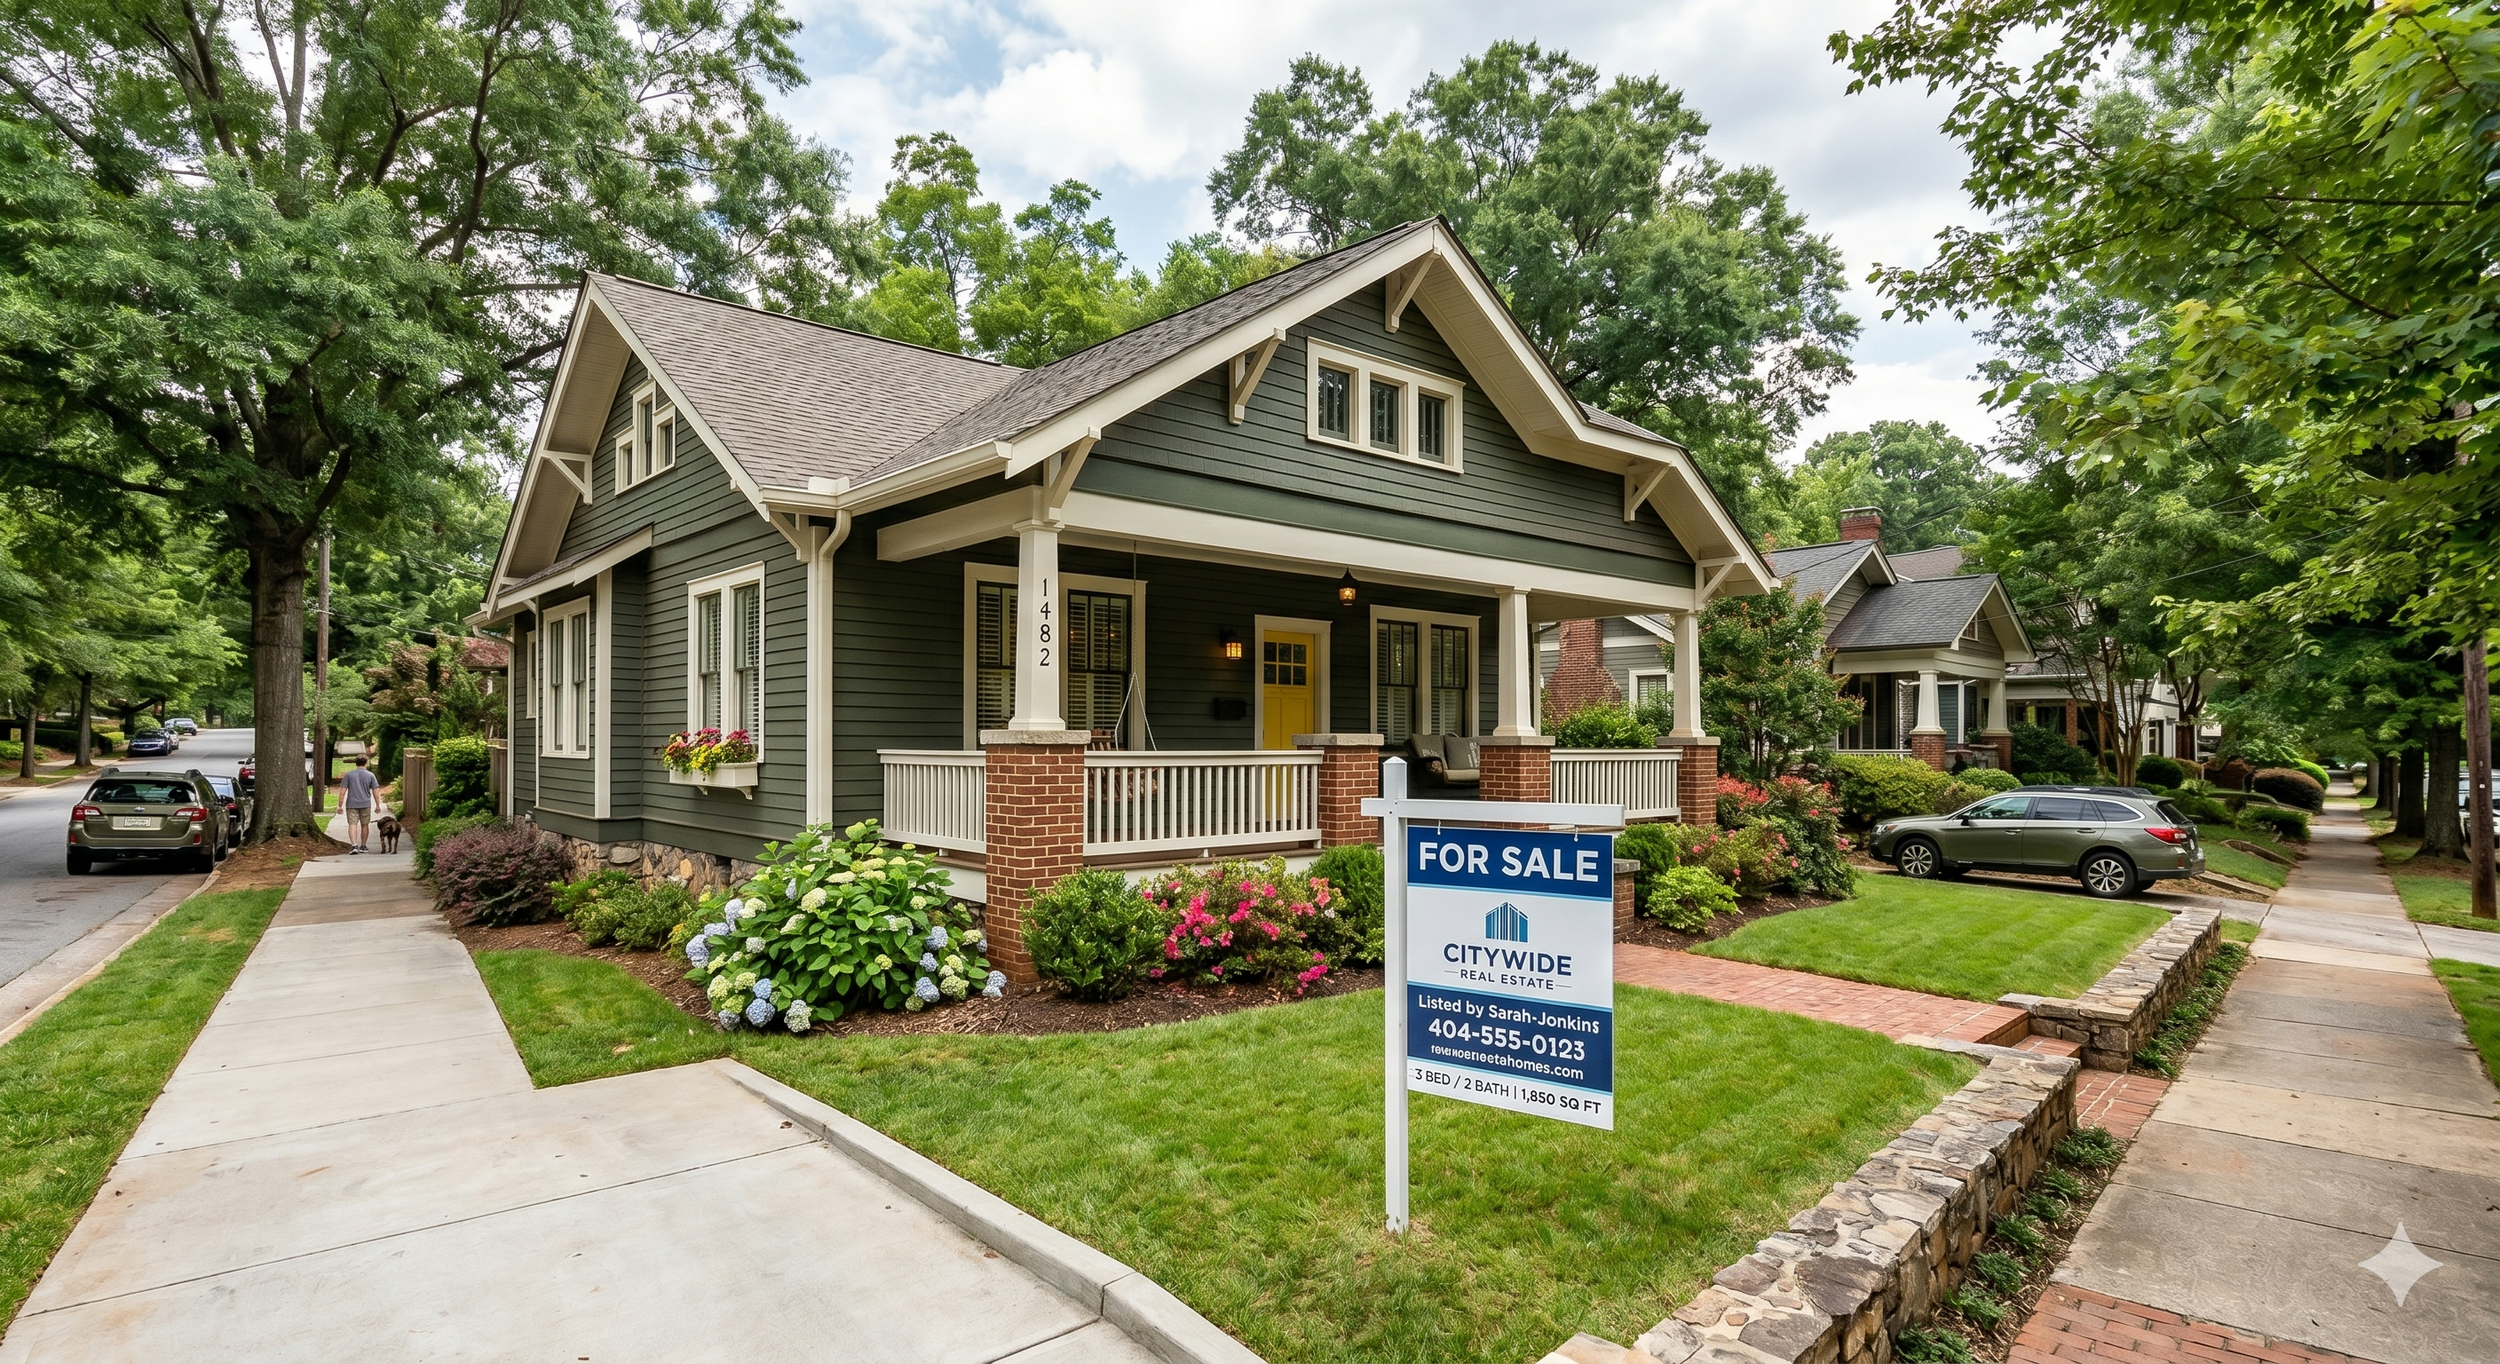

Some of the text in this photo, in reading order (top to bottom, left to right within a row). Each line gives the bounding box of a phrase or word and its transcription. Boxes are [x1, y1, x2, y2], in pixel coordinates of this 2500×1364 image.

[1039, 577, 1052, 667] 1482
[1419, 841, 1599, 883] FOR SALE
[1443, 943, 1572, 976] CITYWIDE
[1460, 969, 1554, 990] REAL ESTATE
[1418, 994, 1600, 1034] Listed by Sarah-Jonkins
[1428, 1018, 1586, 1061] 404-555-0123
[1414, 1068, 1423, 1080] 3
[1425, 1070, 1451, 1085] BED
[1464, 1077, 1472, 1090] 2
[1475, 1079, 1509, 1097] BATH
[1521, 1088, 1556, 1105] 1,850
[1559, 1095, 1580, 1110] SQ
[1583, 1099, 1602, 1114] FT
